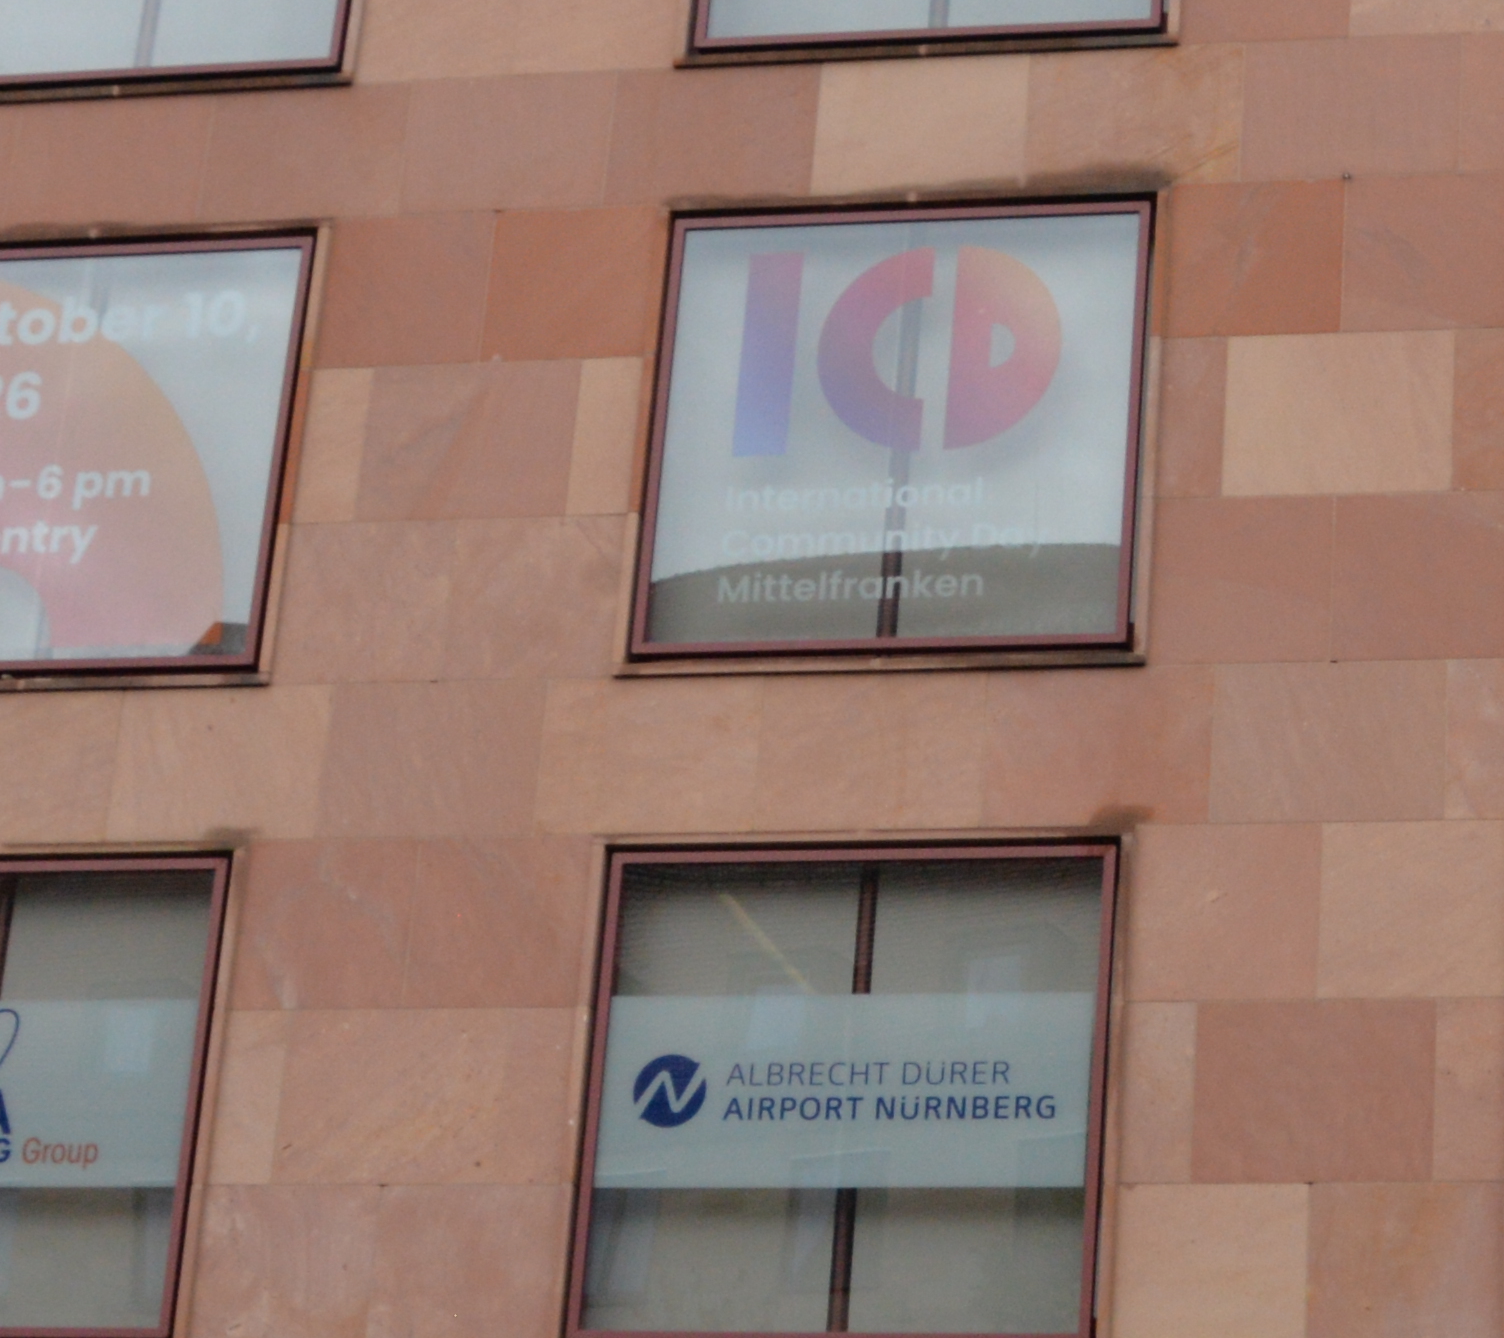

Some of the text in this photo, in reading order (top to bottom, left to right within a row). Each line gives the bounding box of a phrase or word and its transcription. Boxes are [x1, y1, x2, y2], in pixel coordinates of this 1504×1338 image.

[184, 290, 260, 342] 10,
[731, 245, 1063, 457] ICD
[71, 469, 152, 510] pm
[726, 476, 984, 512] International
[722, 521, 1051, 561] Community Day
[716, 568, 984, 604] Mittelfranken
[726, 1060, 1010, 1087] ALBRECHT DÜRER
[723, 1095, 1056, 1121] AIRPORT NÜRNBERG
[21, 1136, 99, 1170] Group
